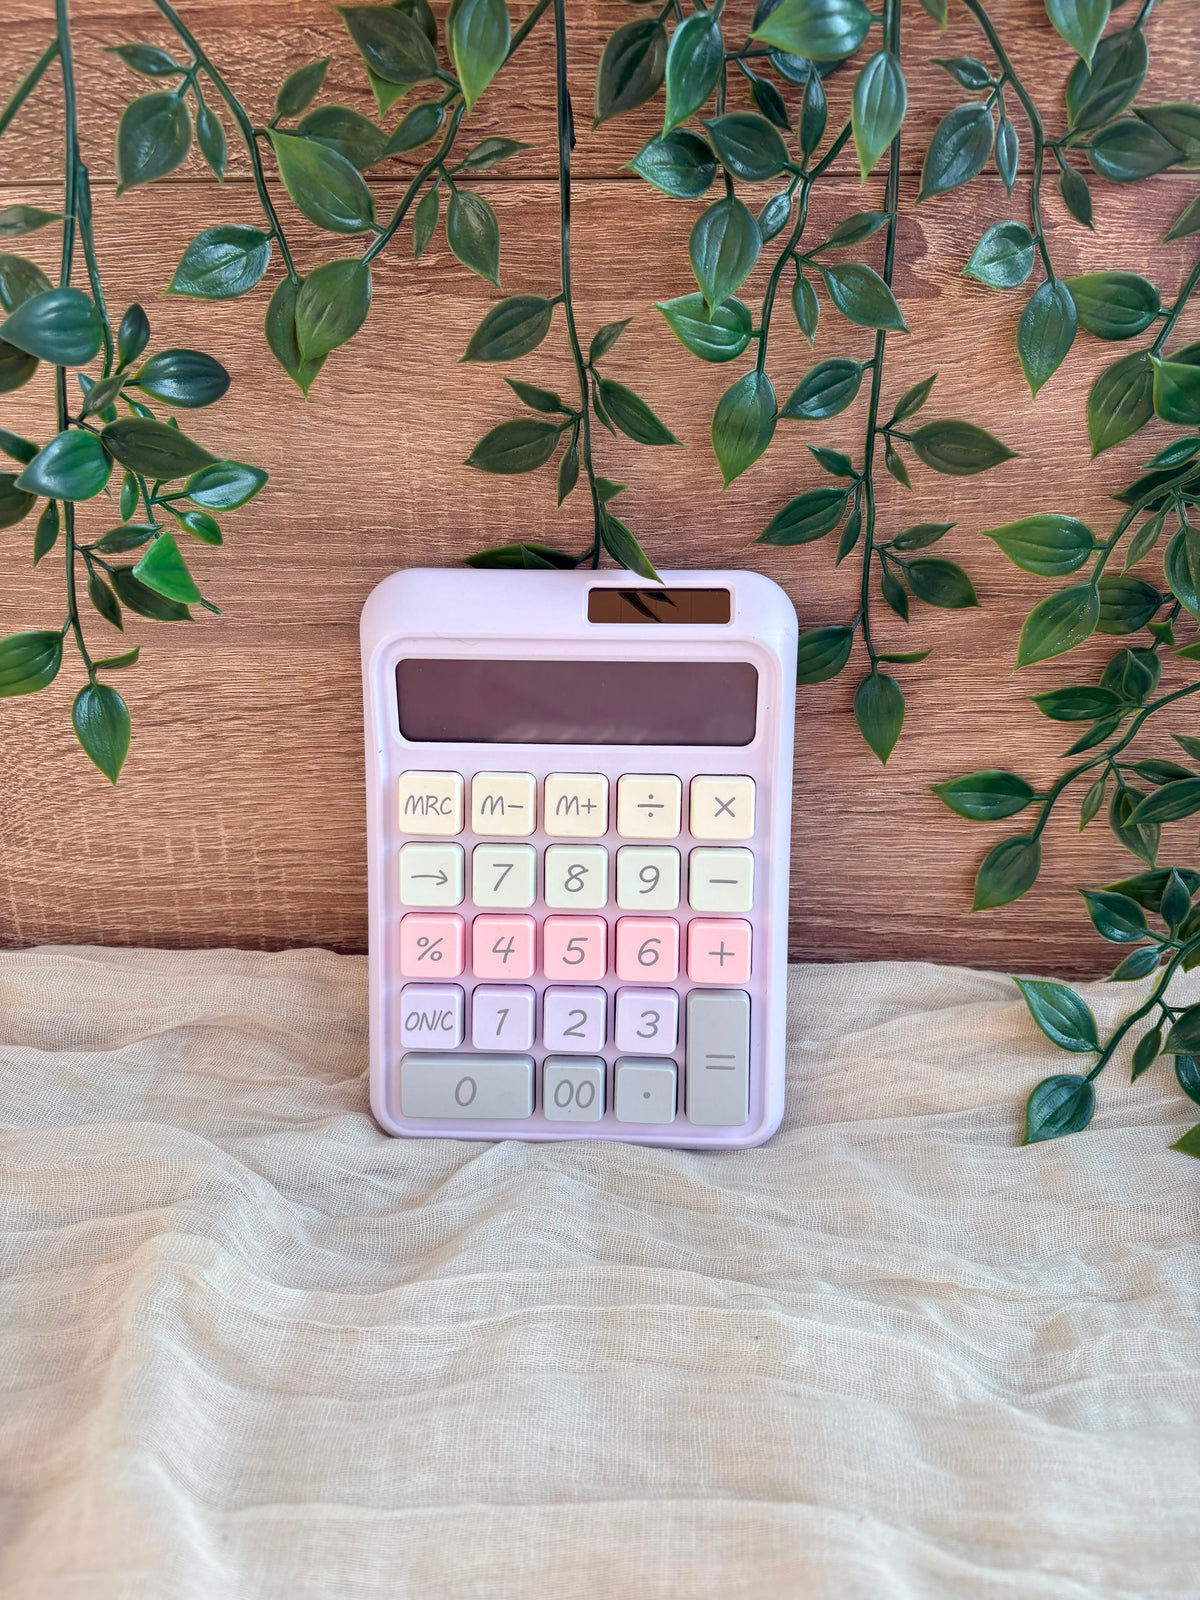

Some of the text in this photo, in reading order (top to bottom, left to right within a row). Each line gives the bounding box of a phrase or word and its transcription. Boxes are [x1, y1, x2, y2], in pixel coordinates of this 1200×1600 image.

[404, 795, 453, 816] MRC
[555, 795, 597, 816] M+
[492, 863, 514, 891] 7
[564, 864, 589, 892] 8
[638, 865, 660, 894] 9
[416, 936, 444, 961] %
[491, 936, 515, 964] 4
[562, 937, 589, 965] 5
[637, 938, 661, 966] 6
[708, 941, 735, 967] +
[404, 1010, 454, 1032] ON/C
[495, 1008, 510, 1036] 1
[562, 1009, 588, 1038] 2
[635, 1010, 661, 1038] 3
[454, 1076, 477, 1107] 0
[553, 1079, 596, 1108] 00
